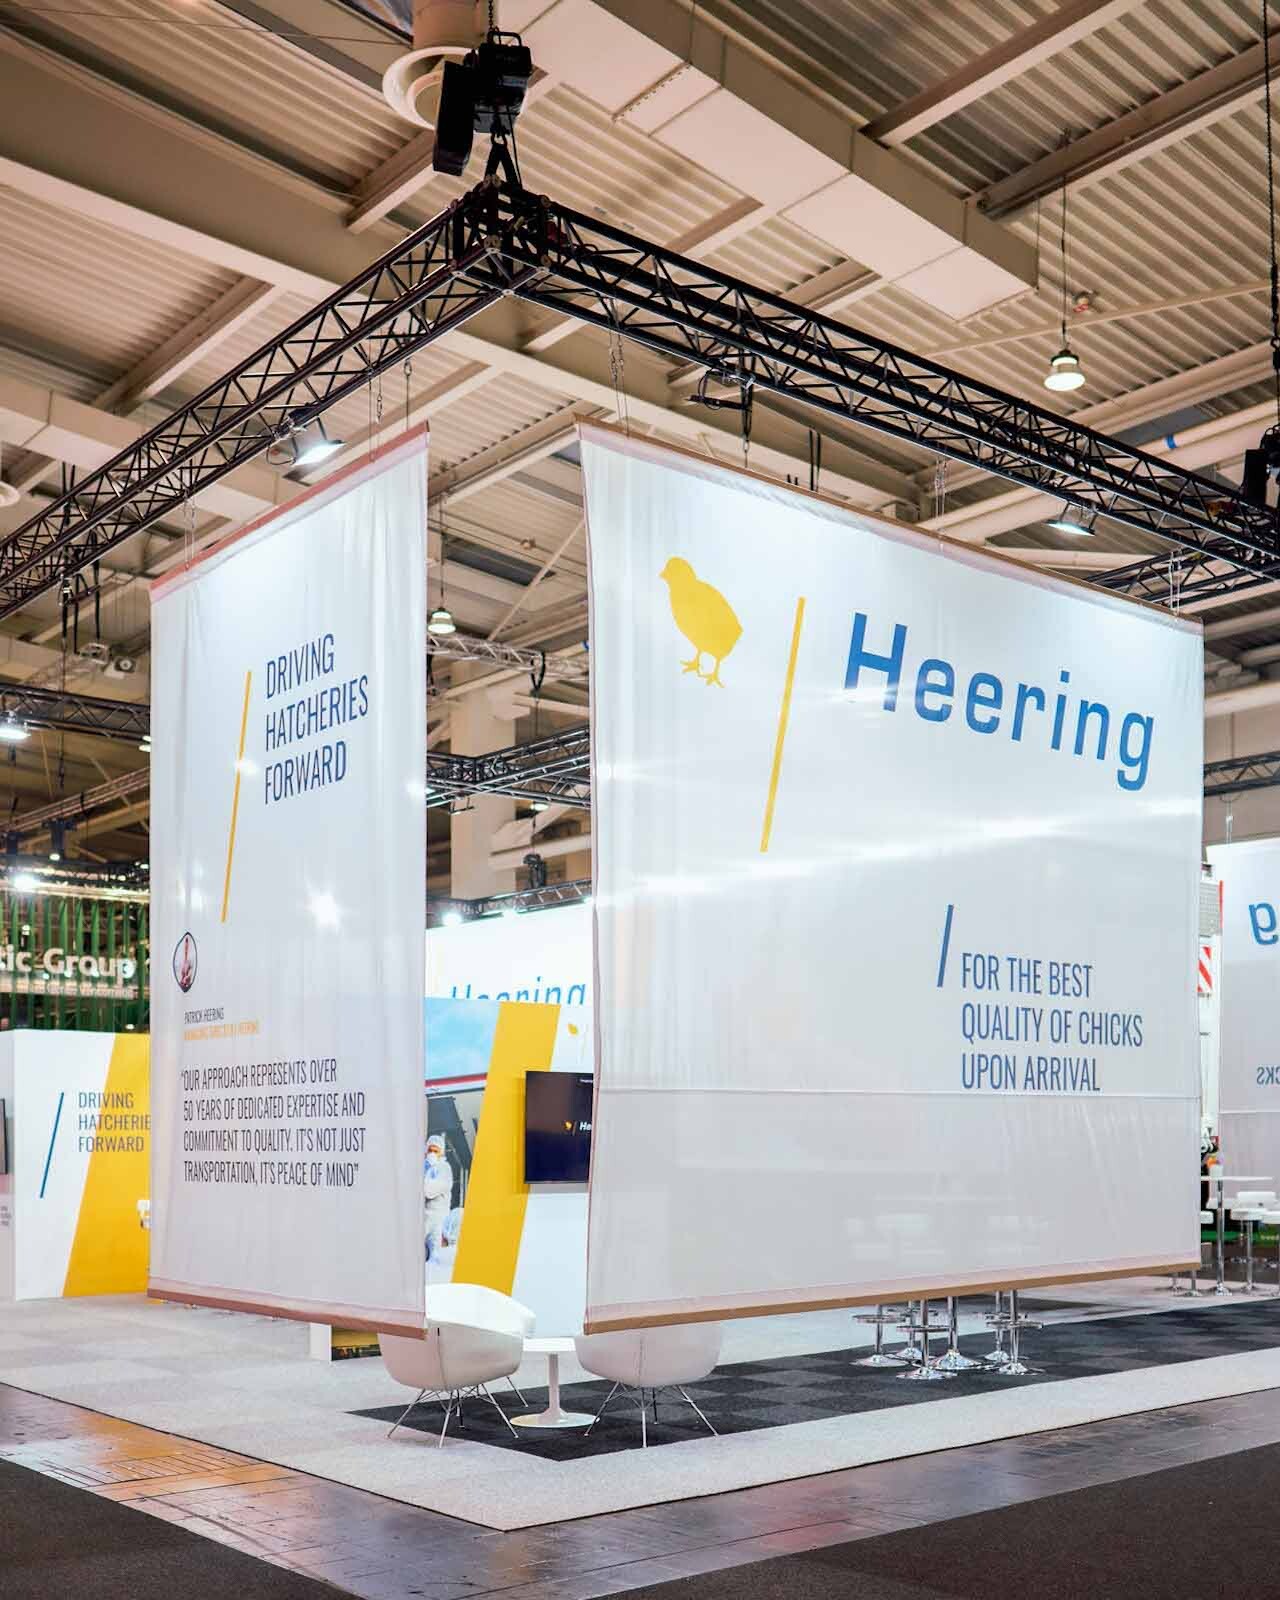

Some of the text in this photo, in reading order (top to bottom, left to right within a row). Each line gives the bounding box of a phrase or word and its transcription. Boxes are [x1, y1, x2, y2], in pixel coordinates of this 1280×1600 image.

[266, 633, 335, 699] DRIVING
[266, 674, 369, 752] HATCHERIES
[844, 612, 1154, 791] Heering
[265, 740, 347, 805] FORWARD
[43, 947, 137, 985] Group
[962, 952, 1092, 998] FOR THE BEST
[962, 1002, 1143, 1047] QUALITY OF CHICKS
[202, 1066, 248, 1089] APPROACH
[250, 1060, 307, 1087] REPRESENTS
[310, 1058, 337, 1083] OVER
[962, 1053, 1101, 1091] UPON ARRIVAL
[78, 1092, 134, 1108] DRIVING
[183, 1092, 365, 1121] 50 YEARS OF DEDICATED EXPERTISE AND
[78, 1114, 151, 1130] HATCHERIE
[183, 1128, 366, 1154] COMMITMENT TO QUALITY. IT'S NOT JUST
[78, 1136, 145, 1152] FORWARD
[184, 1160, 258, 1185] TRANSPORTATION,
[260, 1161, 275, 1184] IT'S
[278, 1162, 307, 1186] PEACE
[310, 1162, 323, 1186] OF
